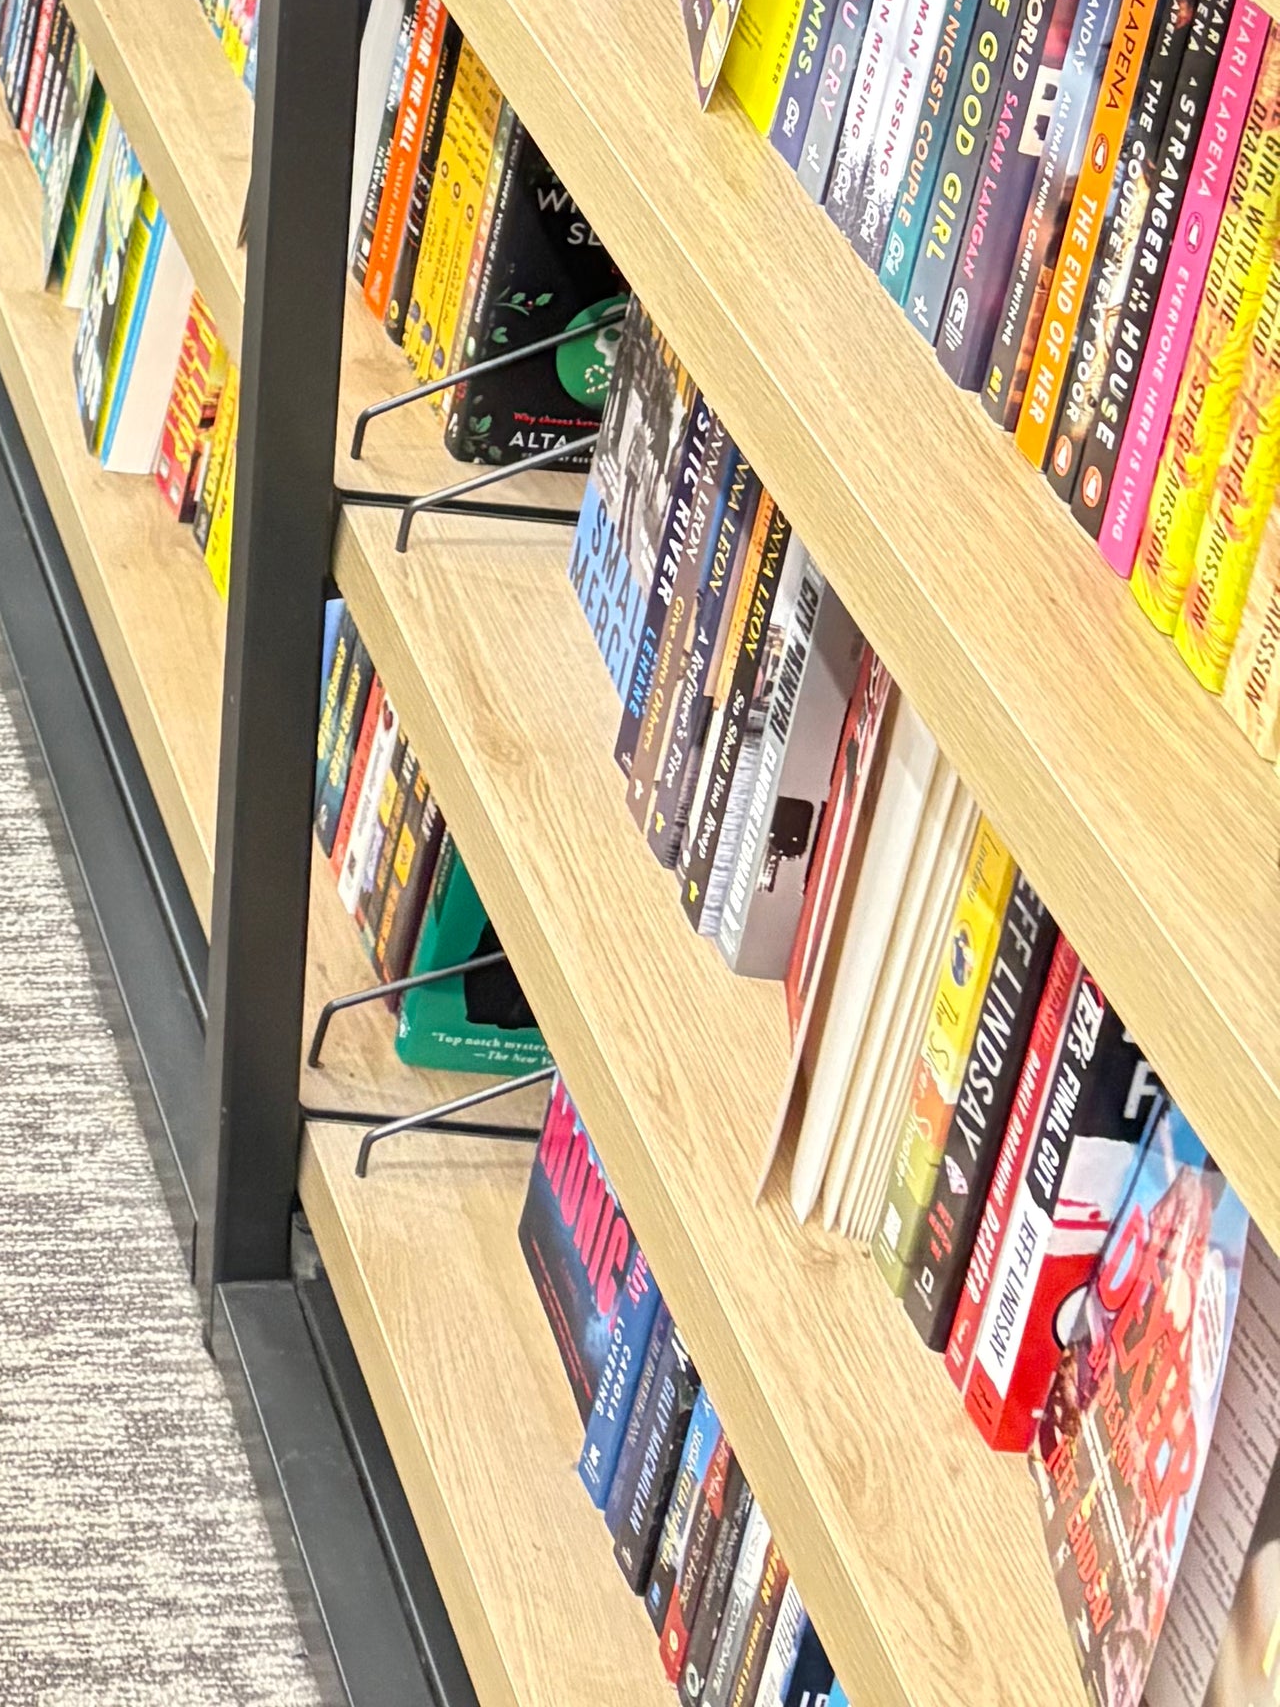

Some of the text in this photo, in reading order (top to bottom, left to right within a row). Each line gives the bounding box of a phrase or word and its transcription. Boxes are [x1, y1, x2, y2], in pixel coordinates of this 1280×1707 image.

[794, 0, 826, 79] MRS.
[822, 43, 847, 123] CRY
[955, 32, 998, 155] GOOD
[994, 90, 1020, 164] SARAH
[925, 172, 962, 262] GIRL
[964, 175, 997, 279] LANGAN
[1055, 258, 1083, 312] END
[1095, 92, 1195, 450] STRANGER HOUSE
[1045, 319, 1065, 363] OF
[1027, 363, 1055, 426] HER
[509, 431, 568, 450] ALTA
[955, 954, 1022, 1163] LINDSAY
[994, 1065, 1082, 1369] FINAL CUT JEFF LINDSAY
[594, 1317, 631, 1422] CAROLA LOVERING
